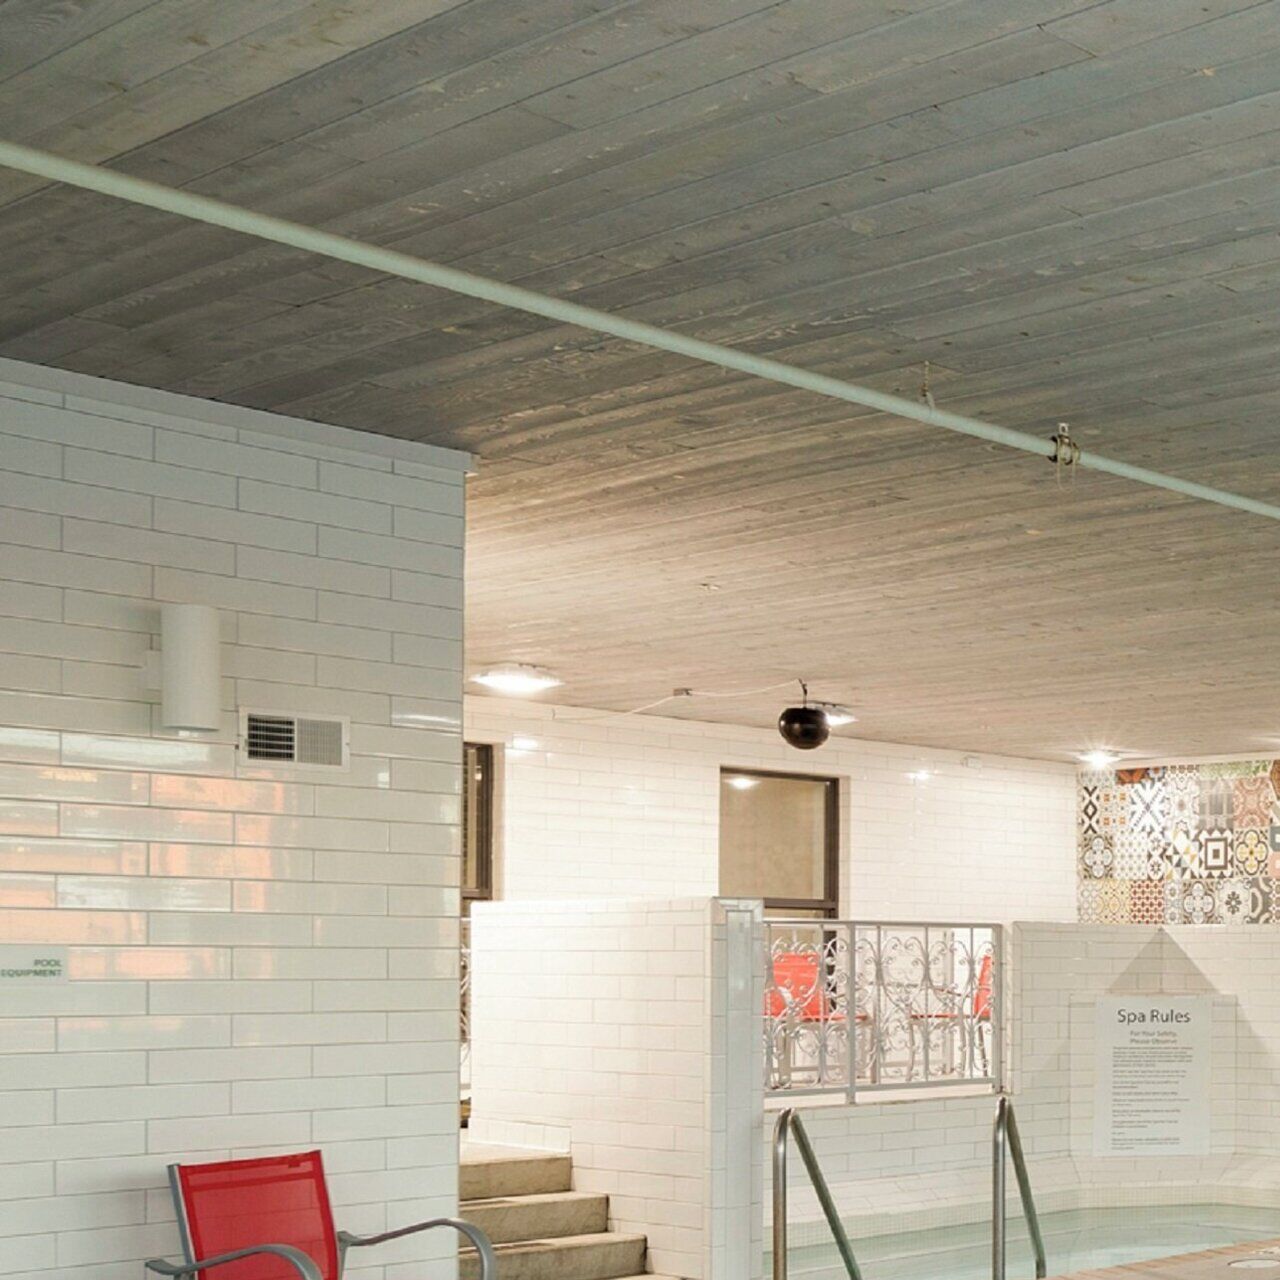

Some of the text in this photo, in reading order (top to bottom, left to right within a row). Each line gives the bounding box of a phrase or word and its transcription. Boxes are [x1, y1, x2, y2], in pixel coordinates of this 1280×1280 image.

[34, 959, 63, 967] POOL
[0, 969, 63, 978] EQUIPMENT
[1117, 1009, 1191, 1026] Spa Rules
